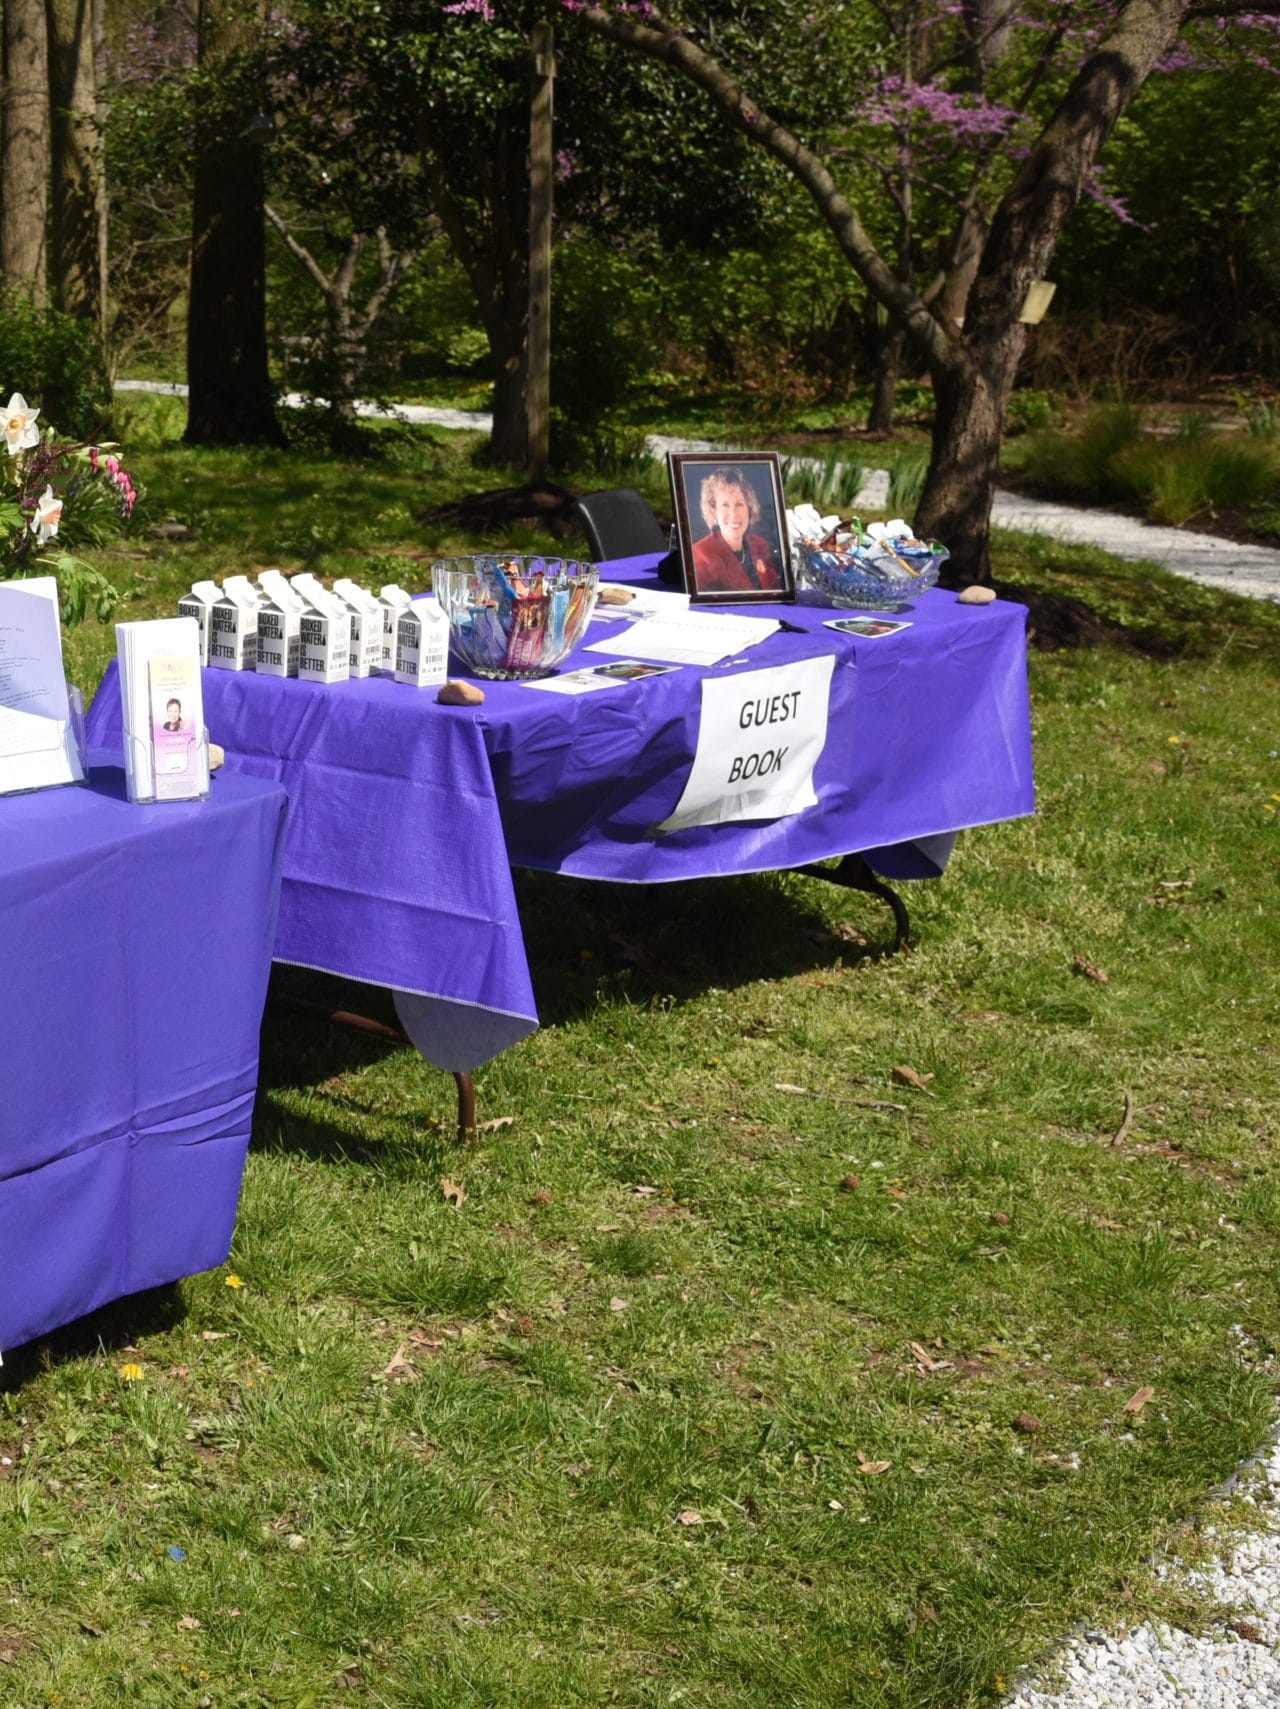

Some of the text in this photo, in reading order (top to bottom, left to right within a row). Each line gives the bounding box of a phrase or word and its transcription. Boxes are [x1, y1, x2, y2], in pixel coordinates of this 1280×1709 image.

[212, 606, 233, 620] BOXED
[258, 612, 279, 626] BOXED
[211, 619, 233, 633] WATER
[257, 625, 280, 639] WATER
[300, 618, 322, 632] BOXED
[397, 619, 416, 635] BOXED
[211, 631, 218, 643] IS
[257, 637, 264, 650] IS
[300, 631, 323, 646] WATER
[397, 633, 416, 648] WATER
[300, 644, 307, 657] IS
[396, 646, 402, 658] IS
[739, 691, 801, 729] GUEST
[727, 746, 789, 784] BOOK
